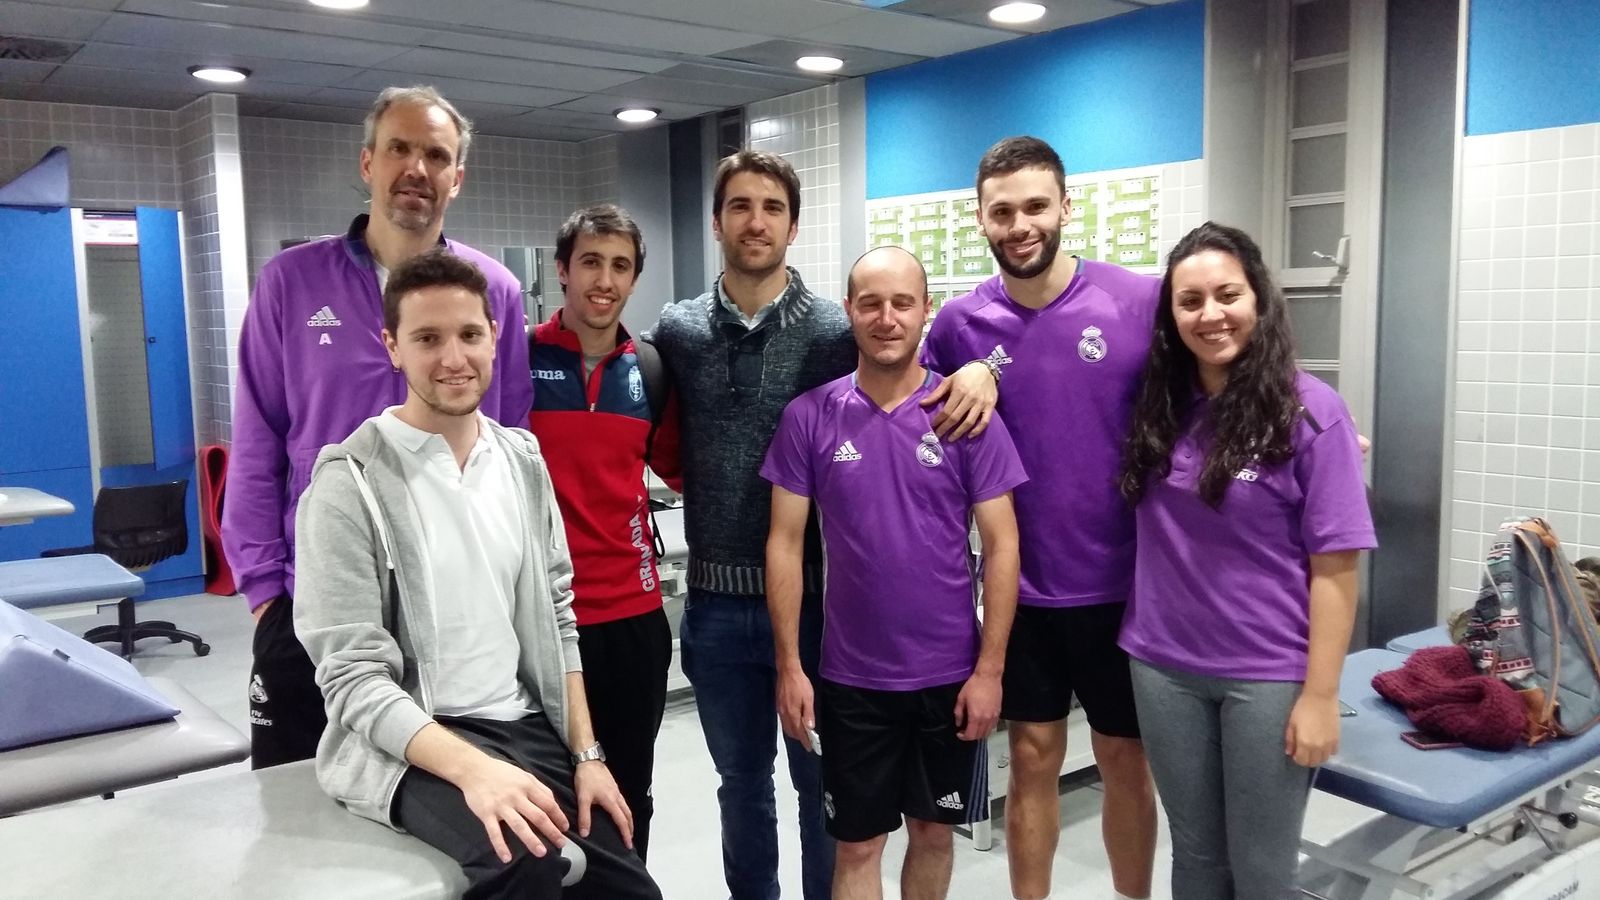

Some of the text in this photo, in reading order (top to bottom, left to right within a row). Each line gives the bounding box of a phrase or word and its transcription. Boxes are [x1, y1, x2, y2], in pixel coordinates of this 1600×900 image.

[306, 319, 342, 327] adidas
[319, 332, 332, 345] A
[832, 453, 862, 462] adidas
[936, 799, 965, 810] adidas
